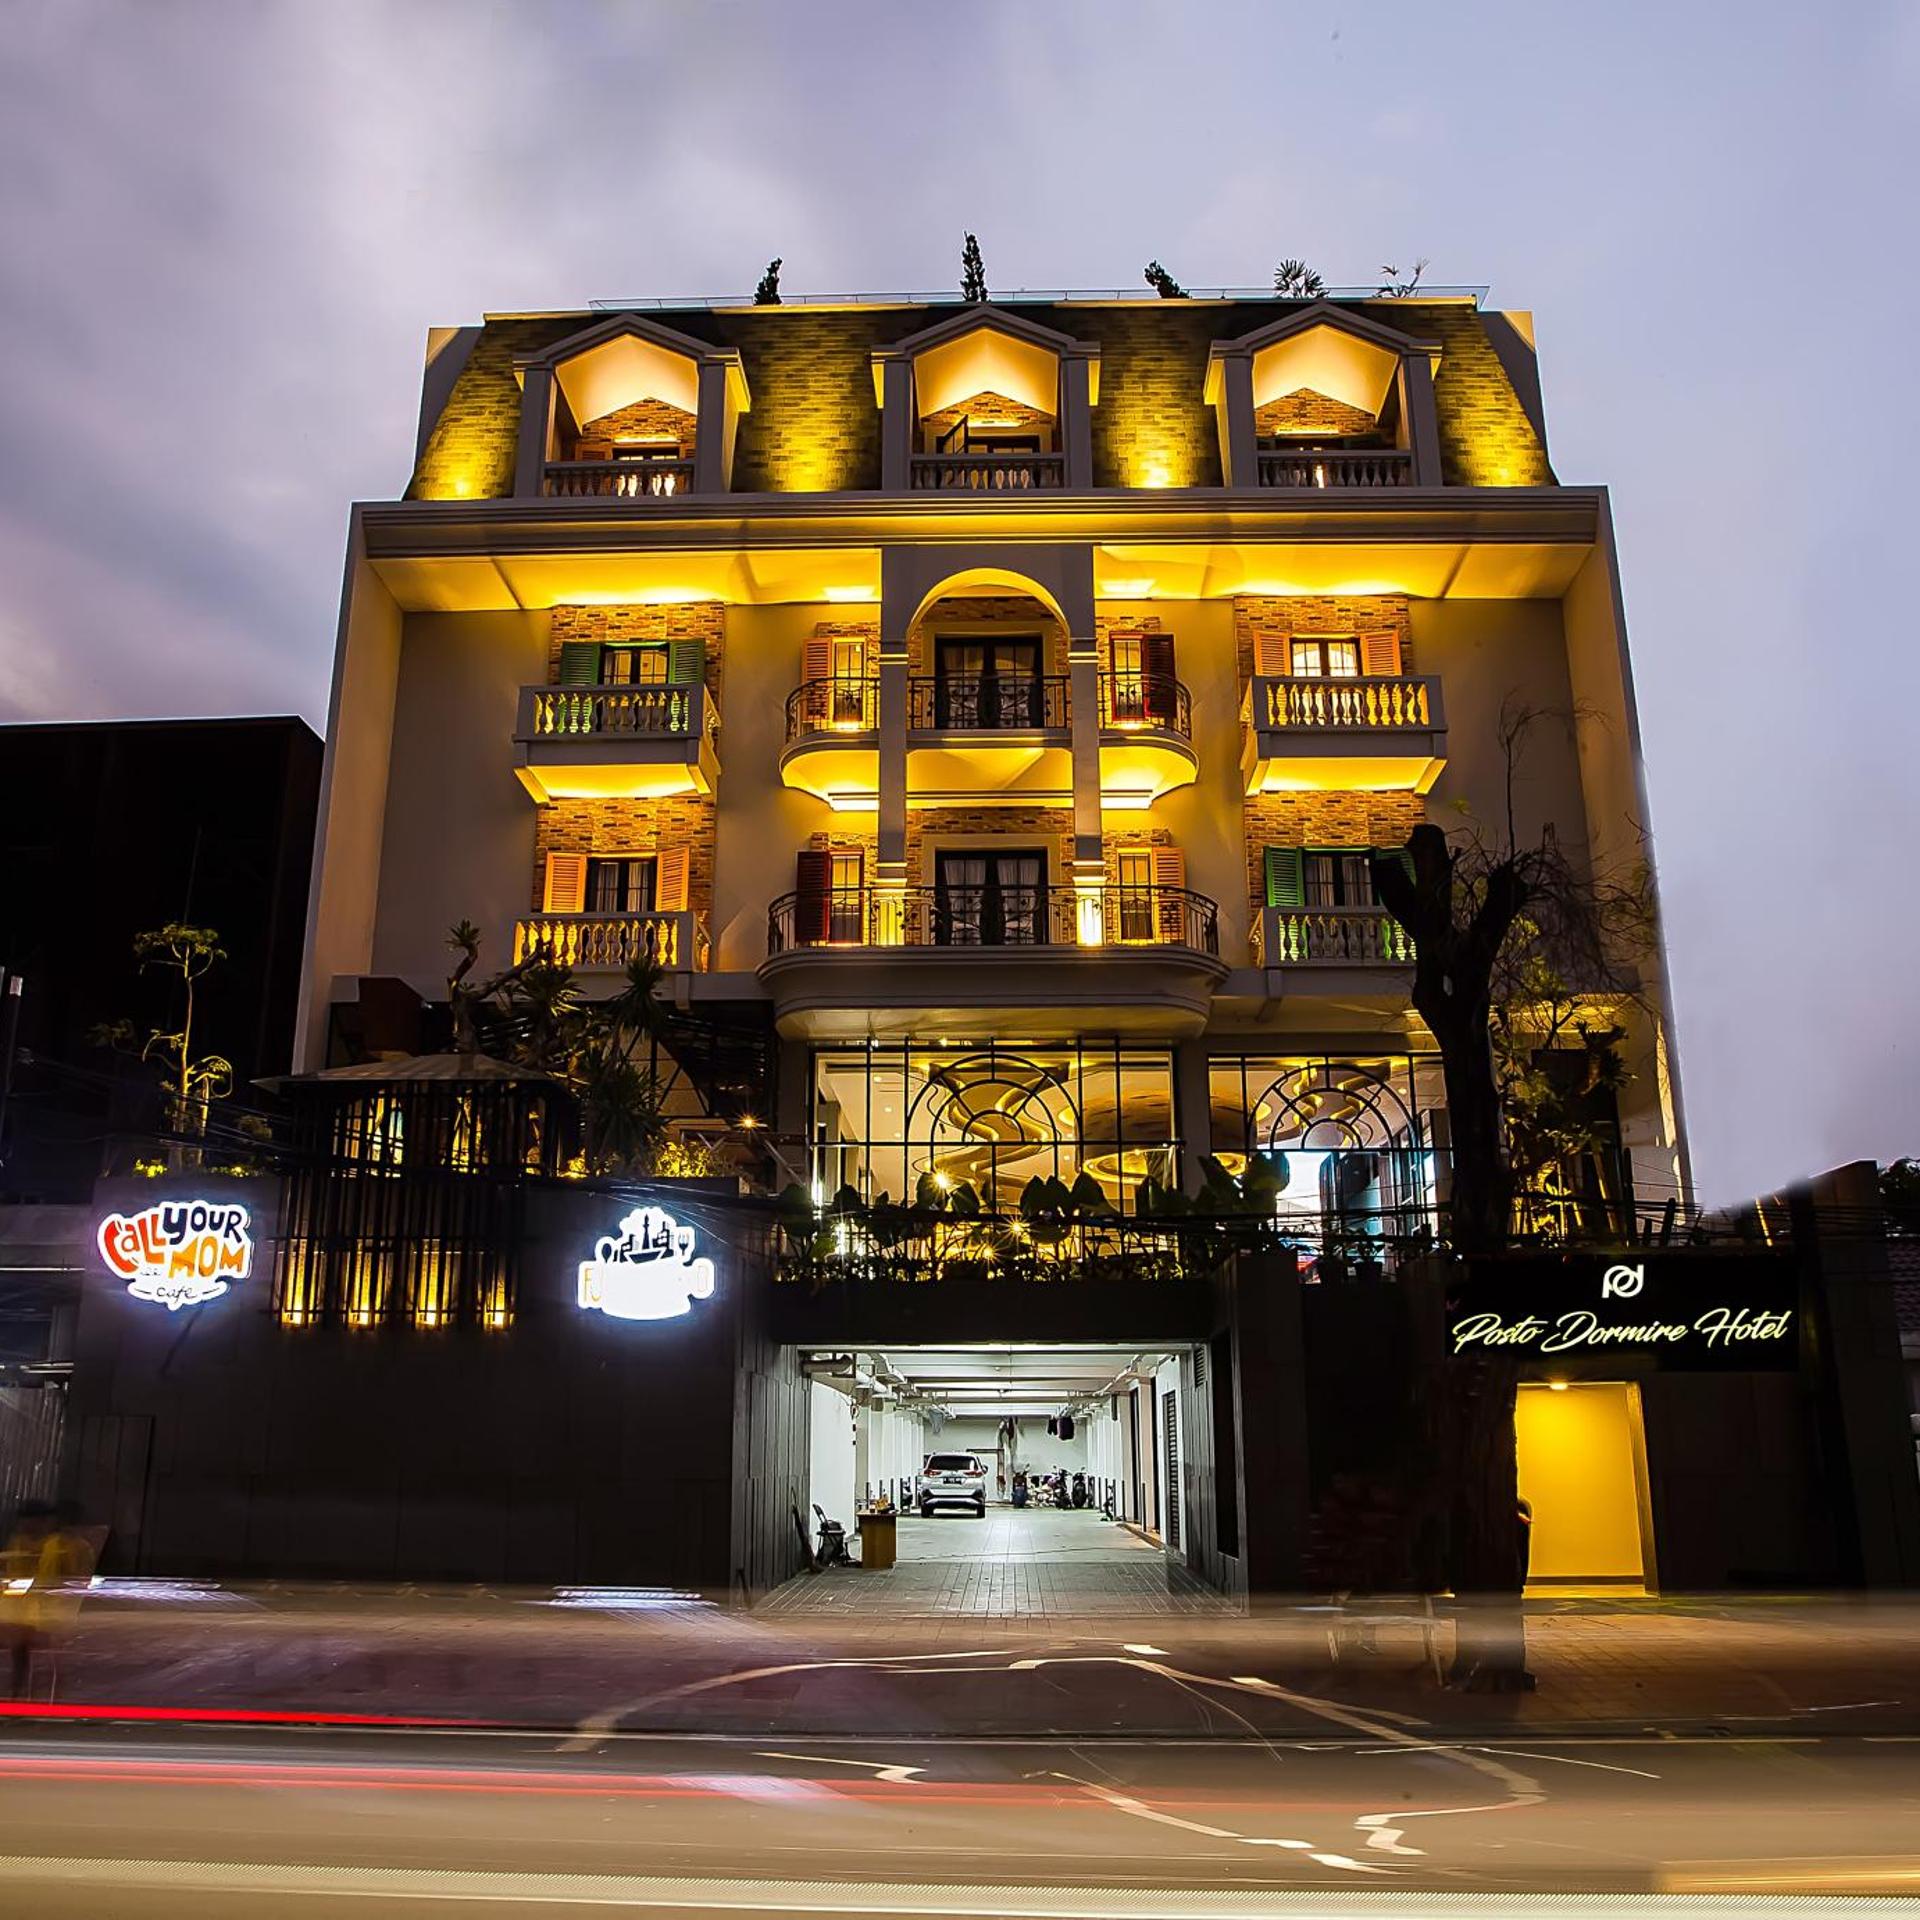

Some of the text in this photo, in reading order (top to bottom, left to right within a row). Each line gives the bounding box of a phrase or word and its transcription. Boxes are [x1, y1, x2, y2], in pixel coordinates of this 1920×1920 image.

[168, 1235, 245, 1279] MOM
[1452, 1308, 1793, 1354] Posto Dormire Hotel
